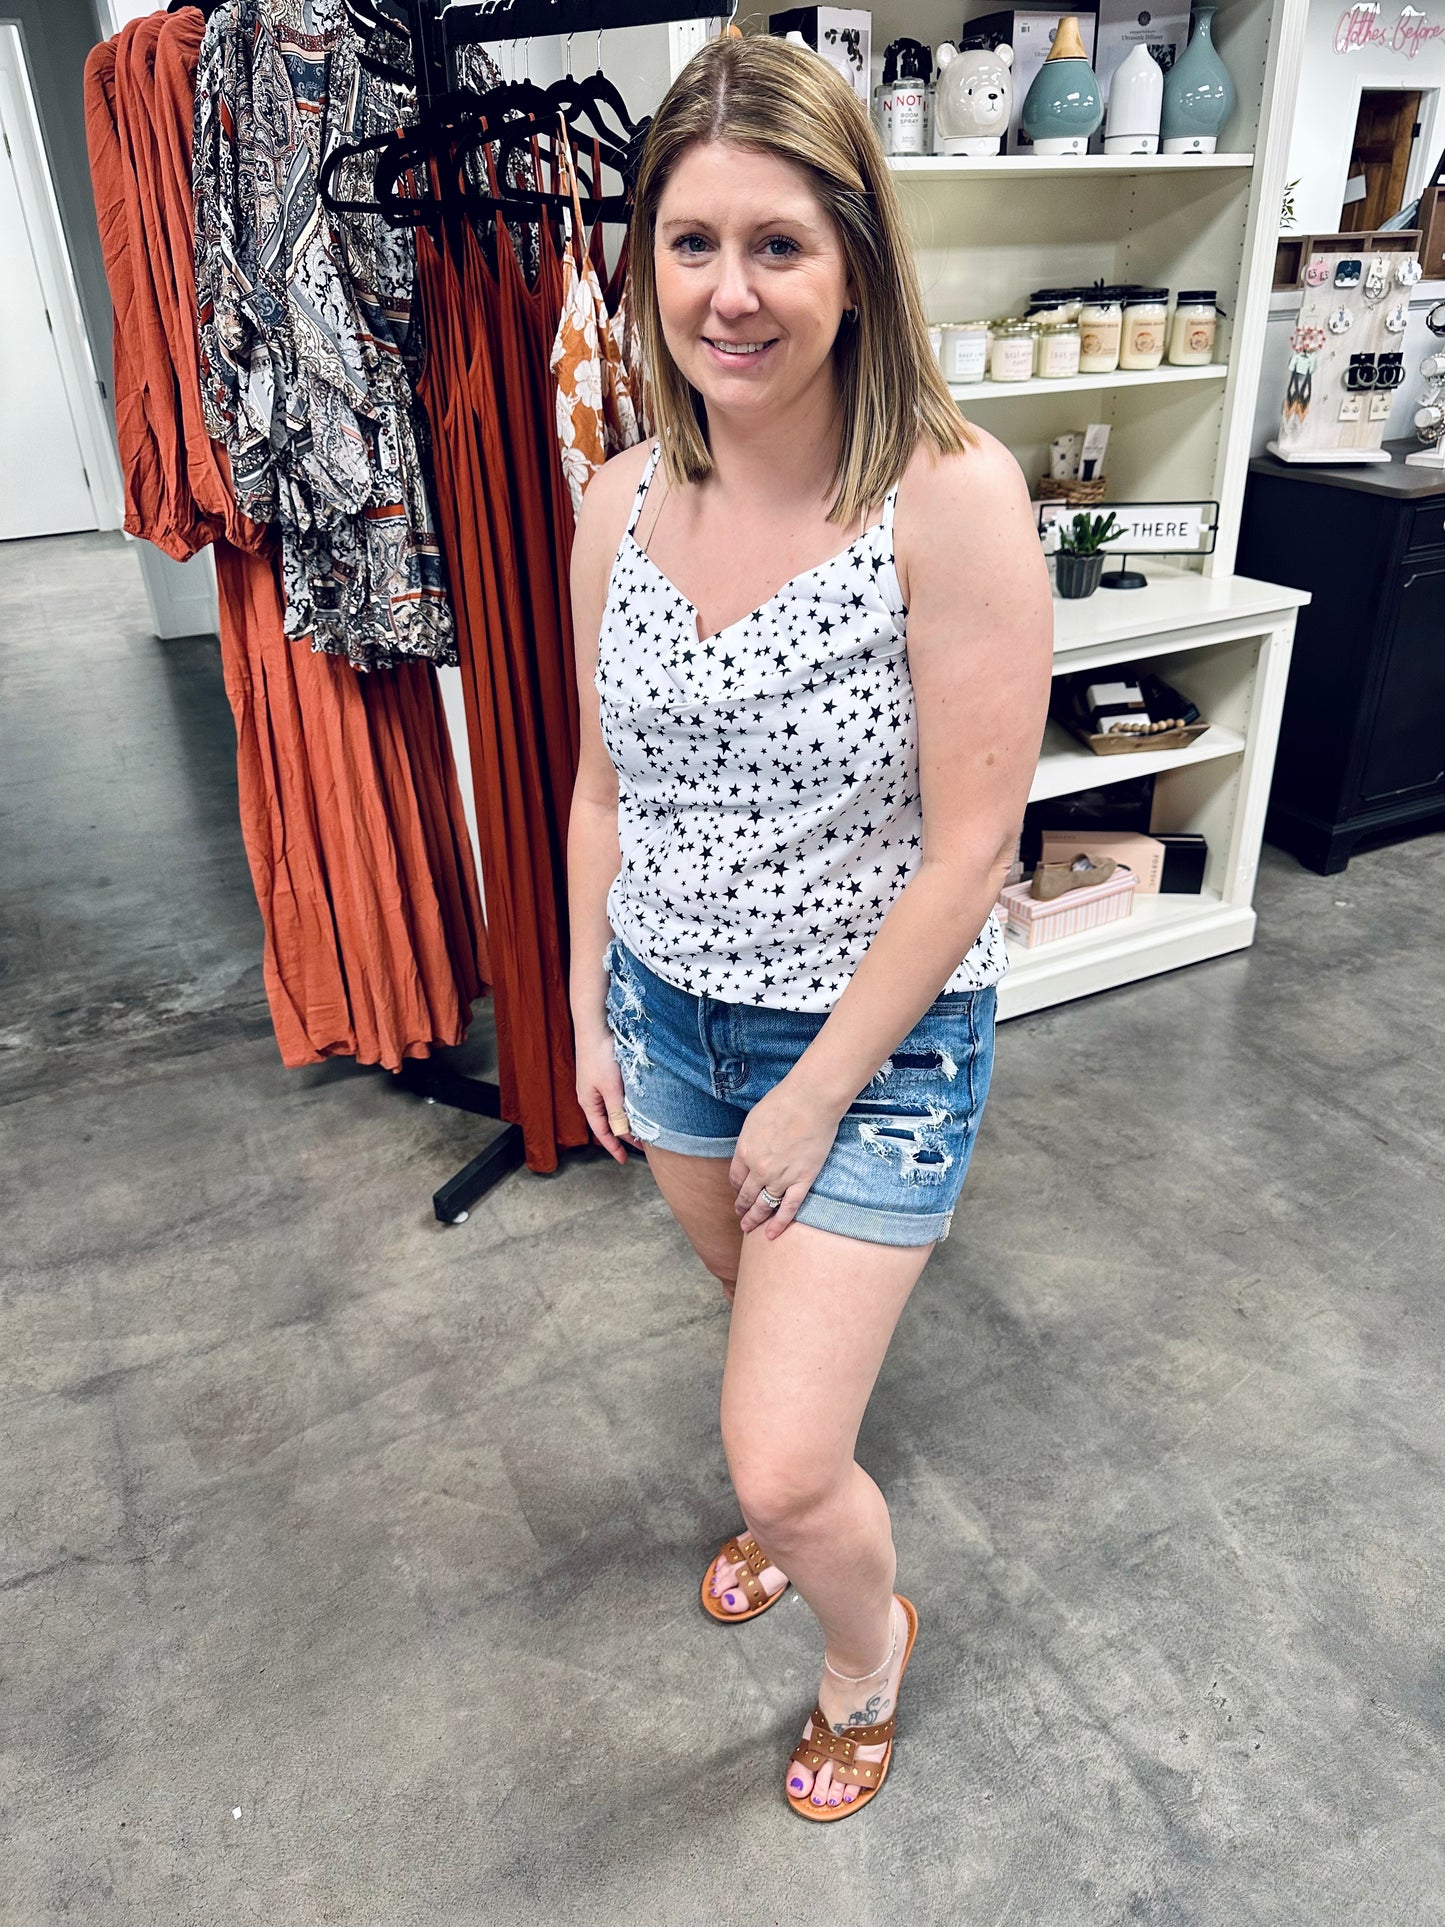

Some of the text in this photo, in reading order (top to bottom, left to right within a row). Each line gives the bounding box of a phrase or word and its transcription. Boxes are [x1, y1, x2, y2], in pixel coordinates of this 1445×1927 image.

[1333, 4, 1445, 58] Clothes Before
[896, 94, 923, 106] NOT
[1131, 521, 1189, 537] THERE
